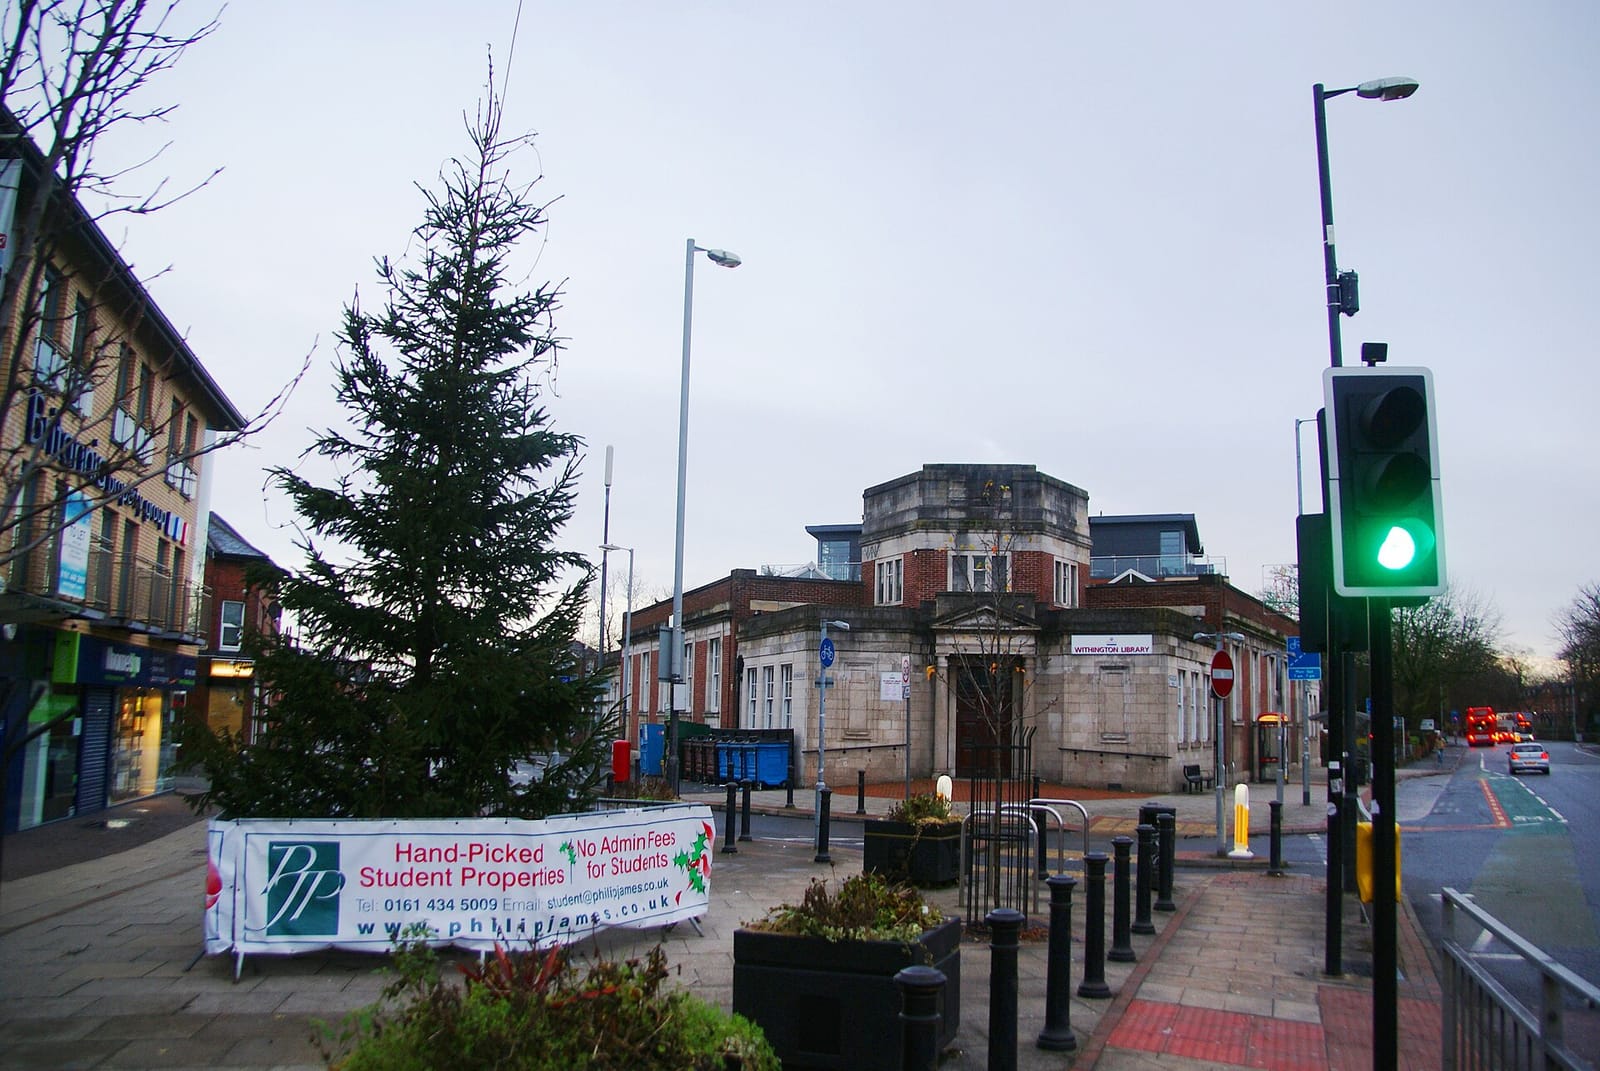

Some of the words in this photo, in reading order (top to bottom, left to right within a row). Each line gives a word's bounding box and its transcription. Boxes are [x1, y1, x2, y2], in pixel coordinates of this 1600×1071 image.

[395, 842, 544, 863] Hand-Picked
[577, 839, 596, 859] No
[601, 833, 645, 856] Admin
[648, 830, 676, 849] Fees
[360, 866, 453, 888] Student
[461, 866, 565, 892] Properties
[586, 861, 606, 880] for
[611, 852, 669, 876] Students
[384, 898, 420, 912] 0161
[427, 898, 454, 912] 434
[460, 898, 498, 912] 5009
[547, 877, 670, 911] student@philipjames.co.uk
